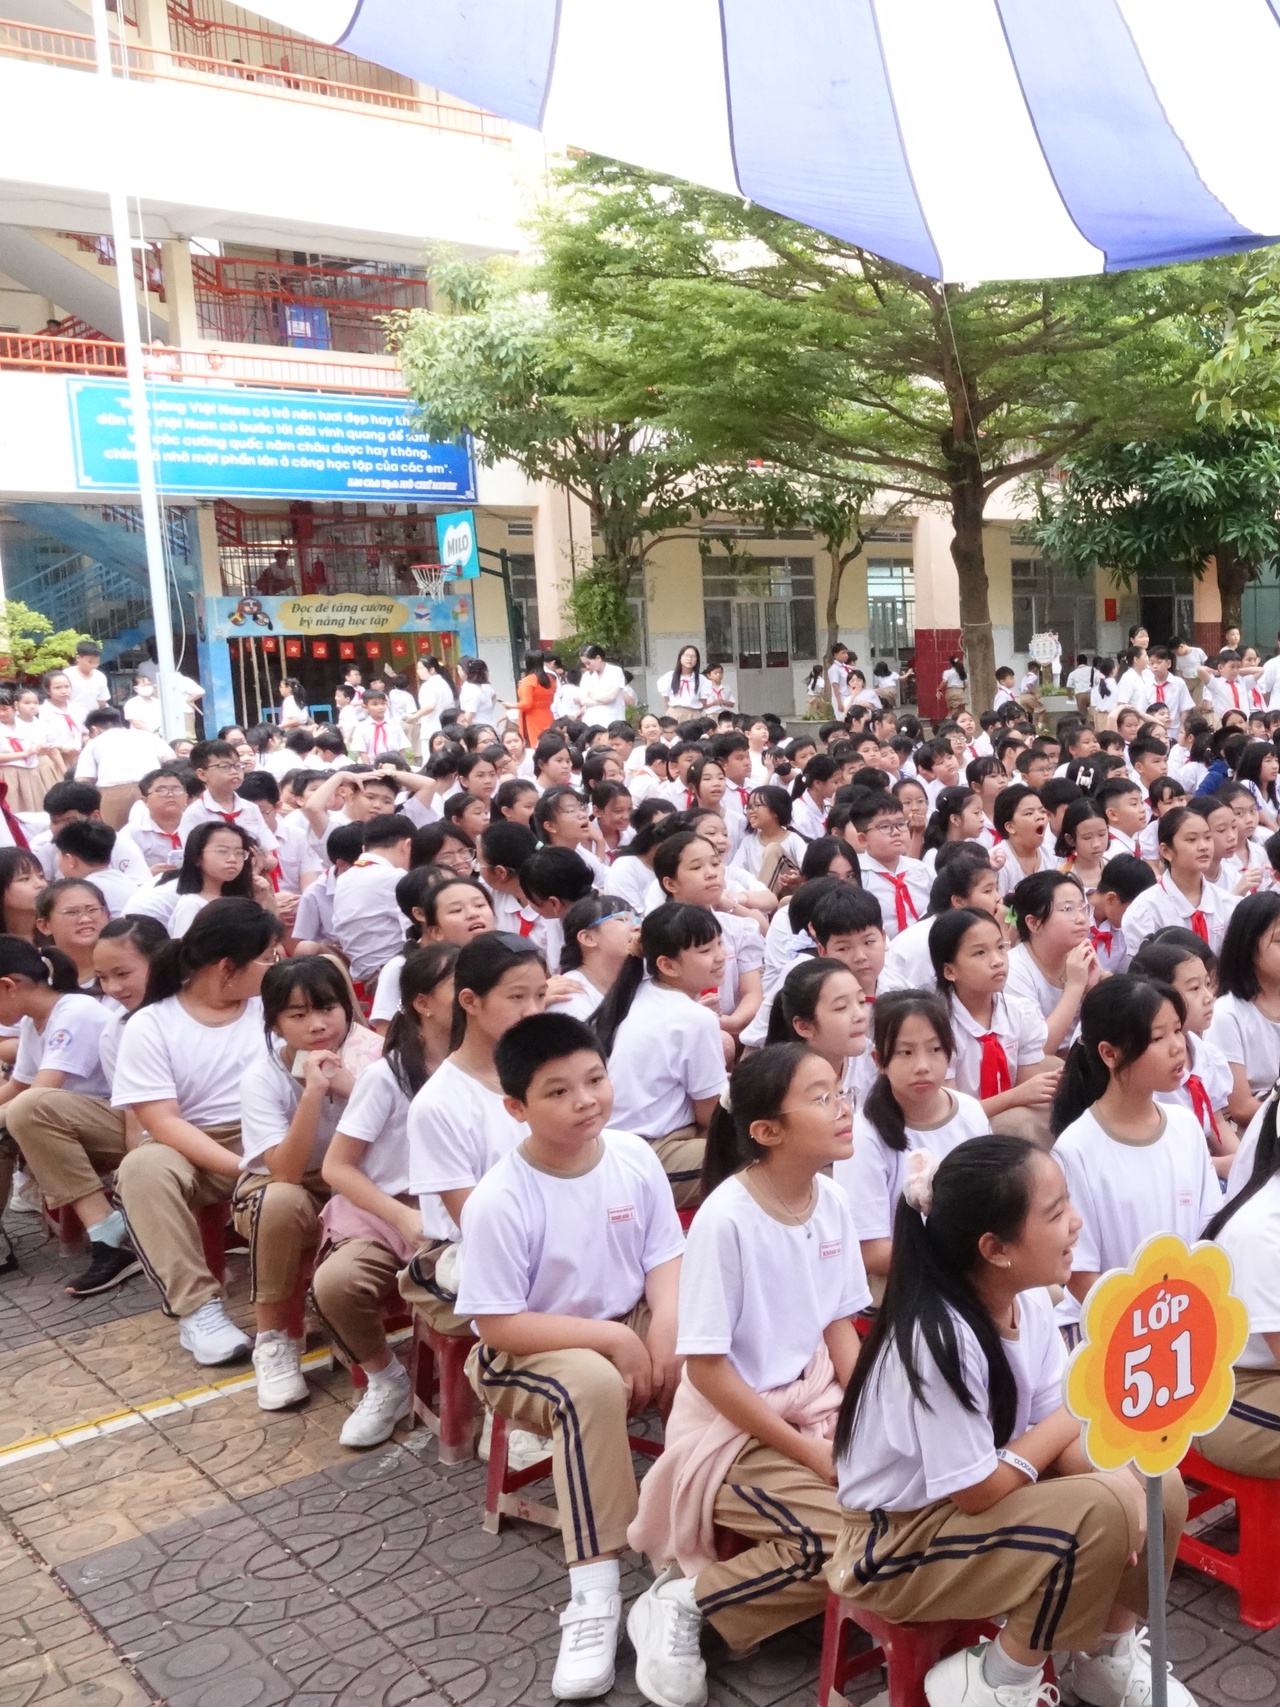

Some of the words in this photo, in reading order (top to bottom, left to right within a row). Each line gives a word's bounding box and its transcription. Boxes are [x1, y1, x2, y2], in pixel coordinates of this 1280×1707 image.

[217, 404, 250, 416] Nam
[370, 414, 393, 427] hay
[184, 418, 217, 431] Nam
[317, 427, 344, 438] vinh
[346, 430, 386, 442] quang
[366, 445, 389, 457] hay
[375, 459, 399, 472] của
[400, 461, 424, 473] các
[447, 535, 469, 557] MILO
[291, 602, 315, 615] Đọc
[1131, 1288, 1191, 1337] LỚP
[1121, 1331, 1196, 1419] 5.1
